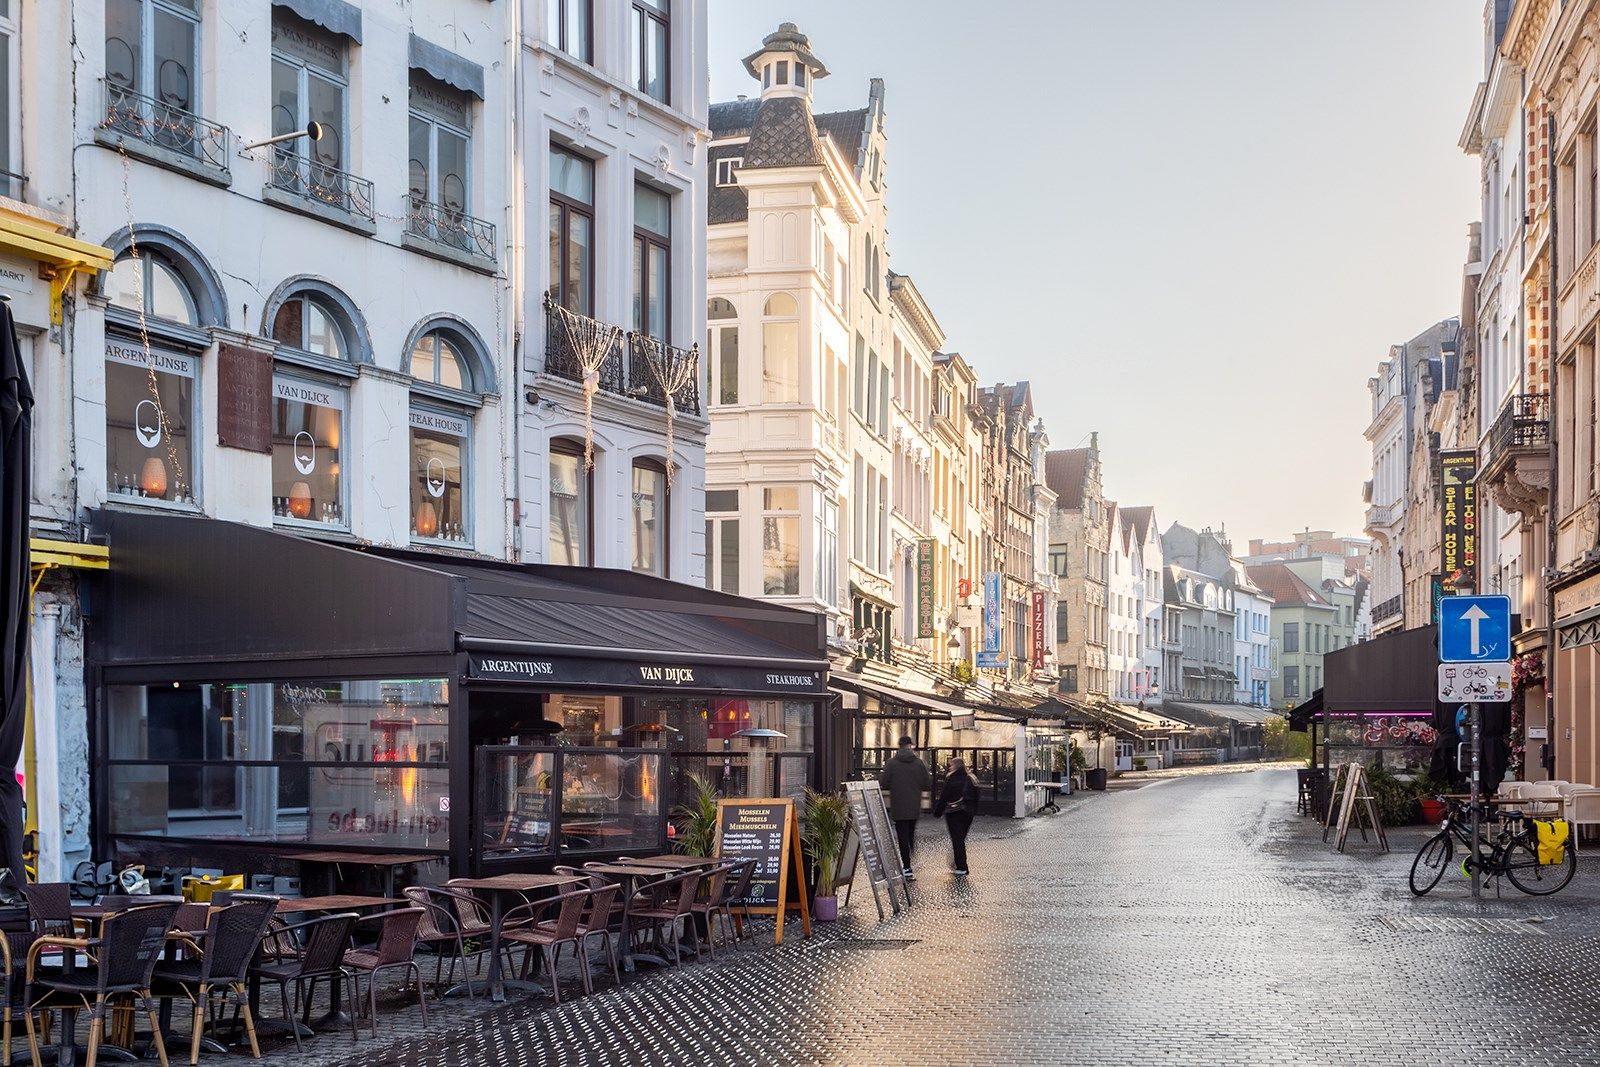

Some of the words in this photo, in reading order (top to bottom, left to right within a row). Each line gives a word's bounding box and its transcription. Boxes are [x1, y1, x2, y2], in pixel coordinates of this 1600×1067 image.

[282, 25, 304, 44] VAN
[306, 37, 338, 60] DIJCK
[416, 85, 433, 101] VAN
[436, 94, 463, 114] DIJCK
[105, 345, 188, 372] ARGENTIJNSE
[278, 384, 299, 398] VAN
[301, 389, 329, 404] DIJCK
[435, 418, 463, 432] HOUSE
[1464, 487, 1474, 500] EL
[1445, 487, 1456, 526] STEAK
[1463, 505, 1475, 530] TORO
[1445, 533, 1456, 571] HOUSE
[1463, 535, 1475, 567] NEGRO
[481, 660, 553, 676] ARGENTIJNSE
[640, 667, 661, 679] VAN
[665, 668, 694, 684] DIJCK
[766, 674, 813, 685] STEAKHOUSE
